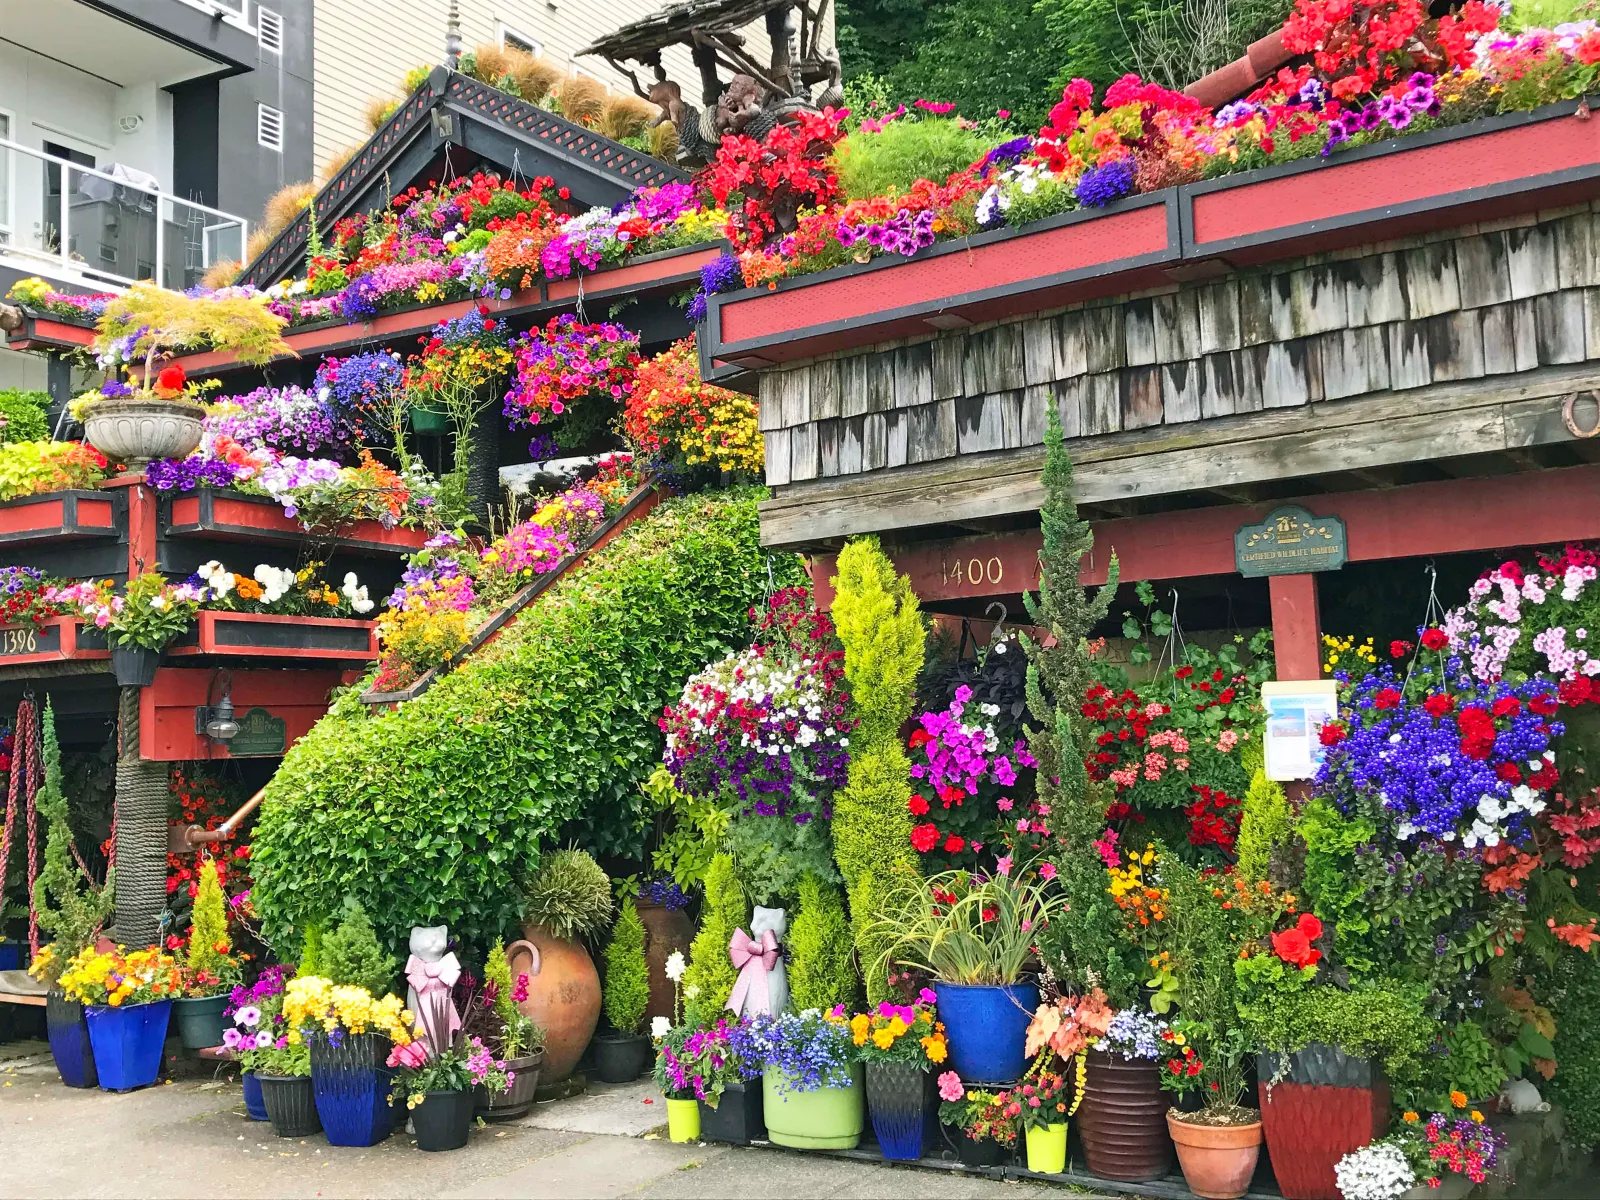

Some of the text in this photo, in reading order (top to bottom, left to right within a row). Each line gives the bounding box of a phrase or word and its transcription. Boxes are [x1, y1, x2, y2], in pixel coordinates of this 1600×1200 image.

[1277, 549, 1308, 557] WILDLIFE
[942, 556, 1003, 586] 1400
[4, 629, 36, 653] 1396
